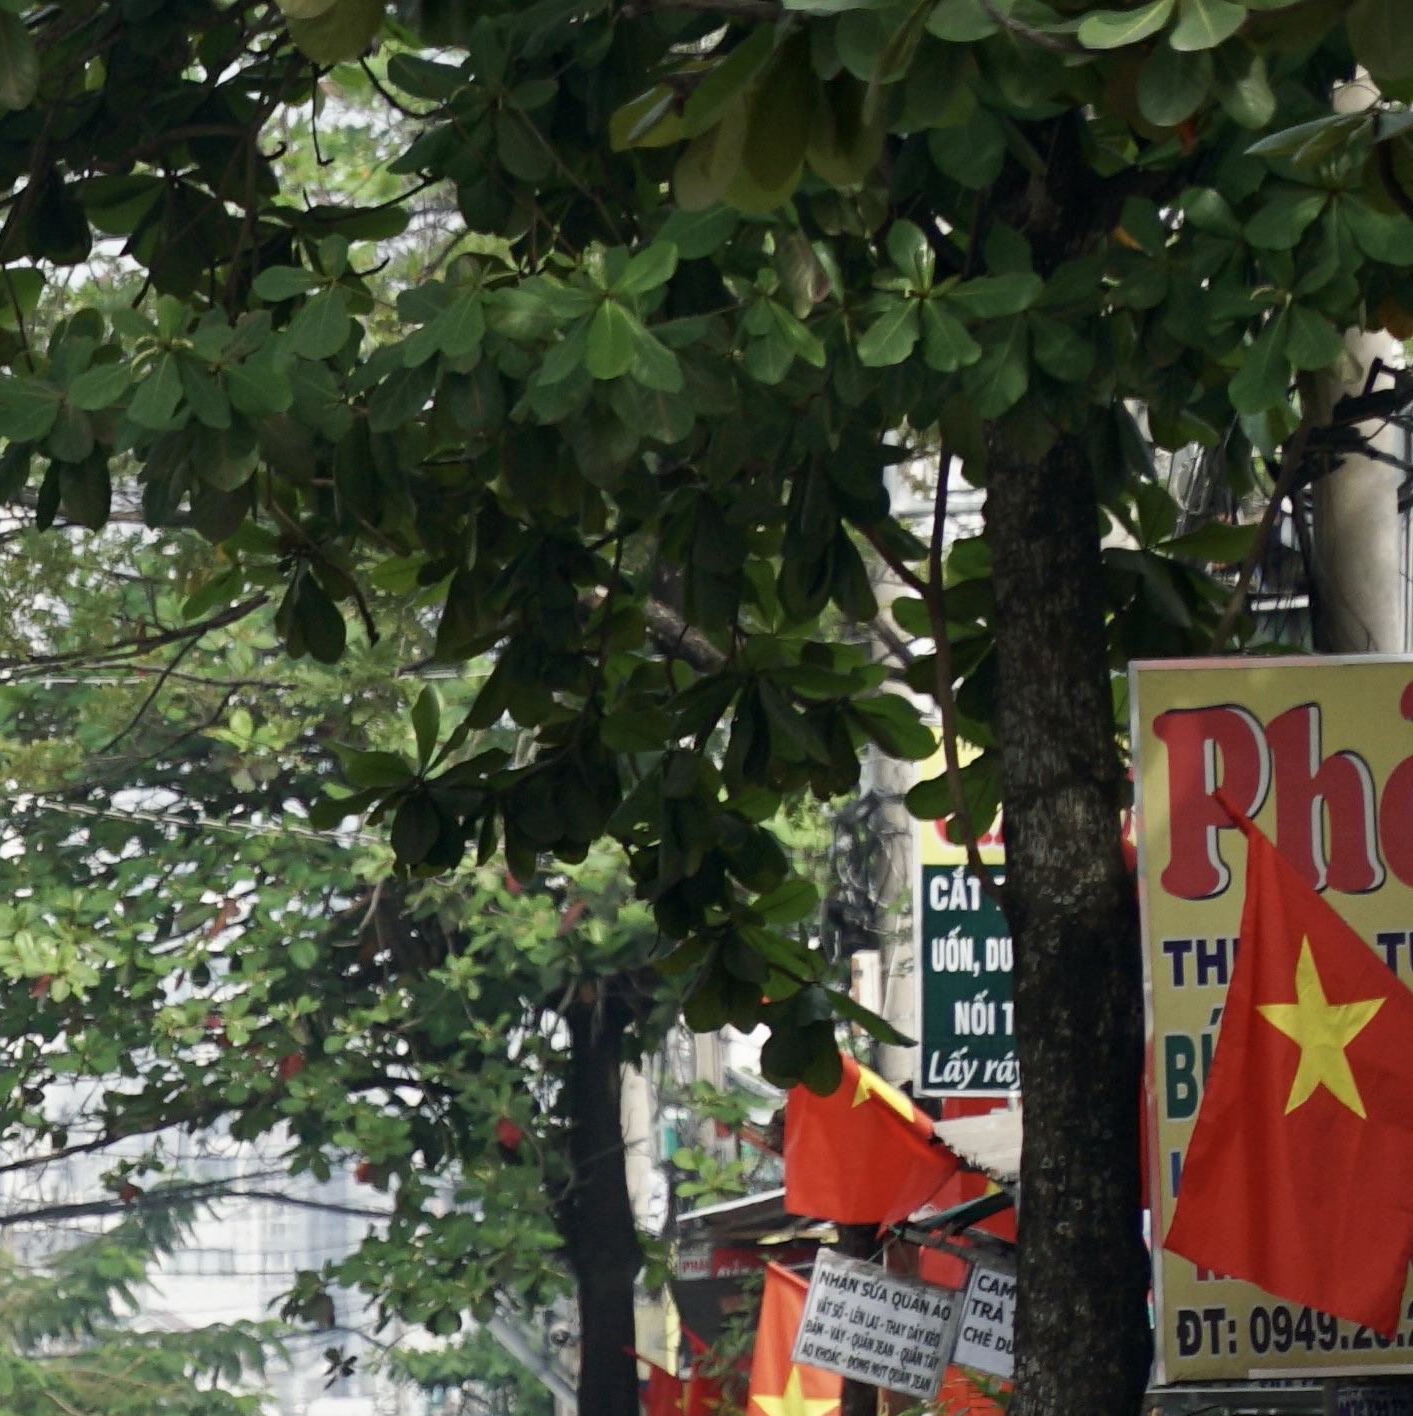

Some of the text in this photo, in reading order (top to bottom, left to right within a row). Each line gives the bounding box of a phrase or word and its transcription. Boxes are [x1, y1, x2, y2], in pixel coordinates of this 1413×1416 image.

[931, 925, 981, 978] UỐN,
[954, 990, 996, 1037] NỐI
[928, 1046, 979, 1090] Lấy
[1177, 1308, 1238, 1358] ĐT:
